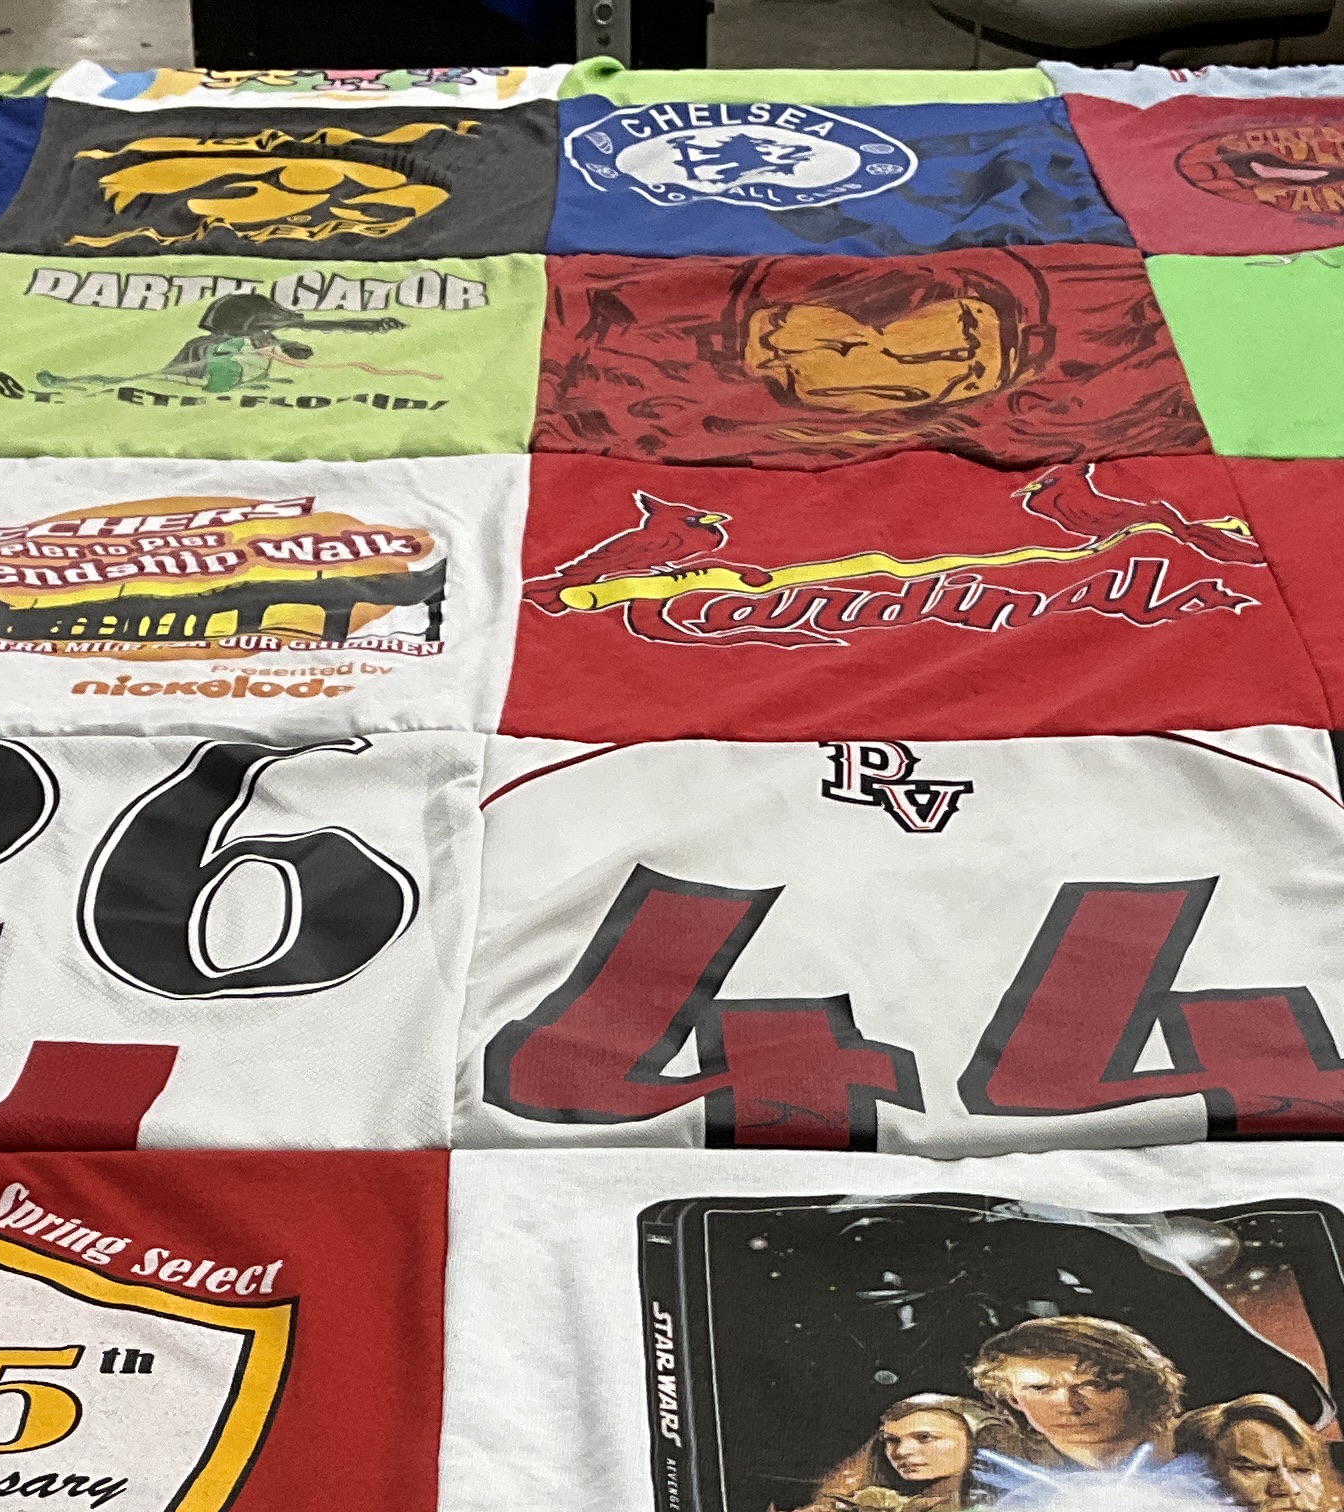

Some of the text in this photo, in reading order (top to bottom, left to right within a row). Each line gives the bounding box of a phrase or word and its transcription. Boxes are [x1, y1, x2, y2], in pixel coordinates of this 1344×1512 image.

[621, 103, 834, 137] CHELSEA
[24, 267, 490, 311] DARTH GATOR
[0, 532, 220, 560] Pier to Pier
[254, 530, 418, 566] Walk
[623, 558, 1262, 650] Cardinals
[217, 636, 281, 650] OUR
[819, 740, 973, 834] PV
[131, 1247, 285, 1296] Select
[653, 1301, 677, 1375] STAR
[658, 1375, 683, 1449] WARS
